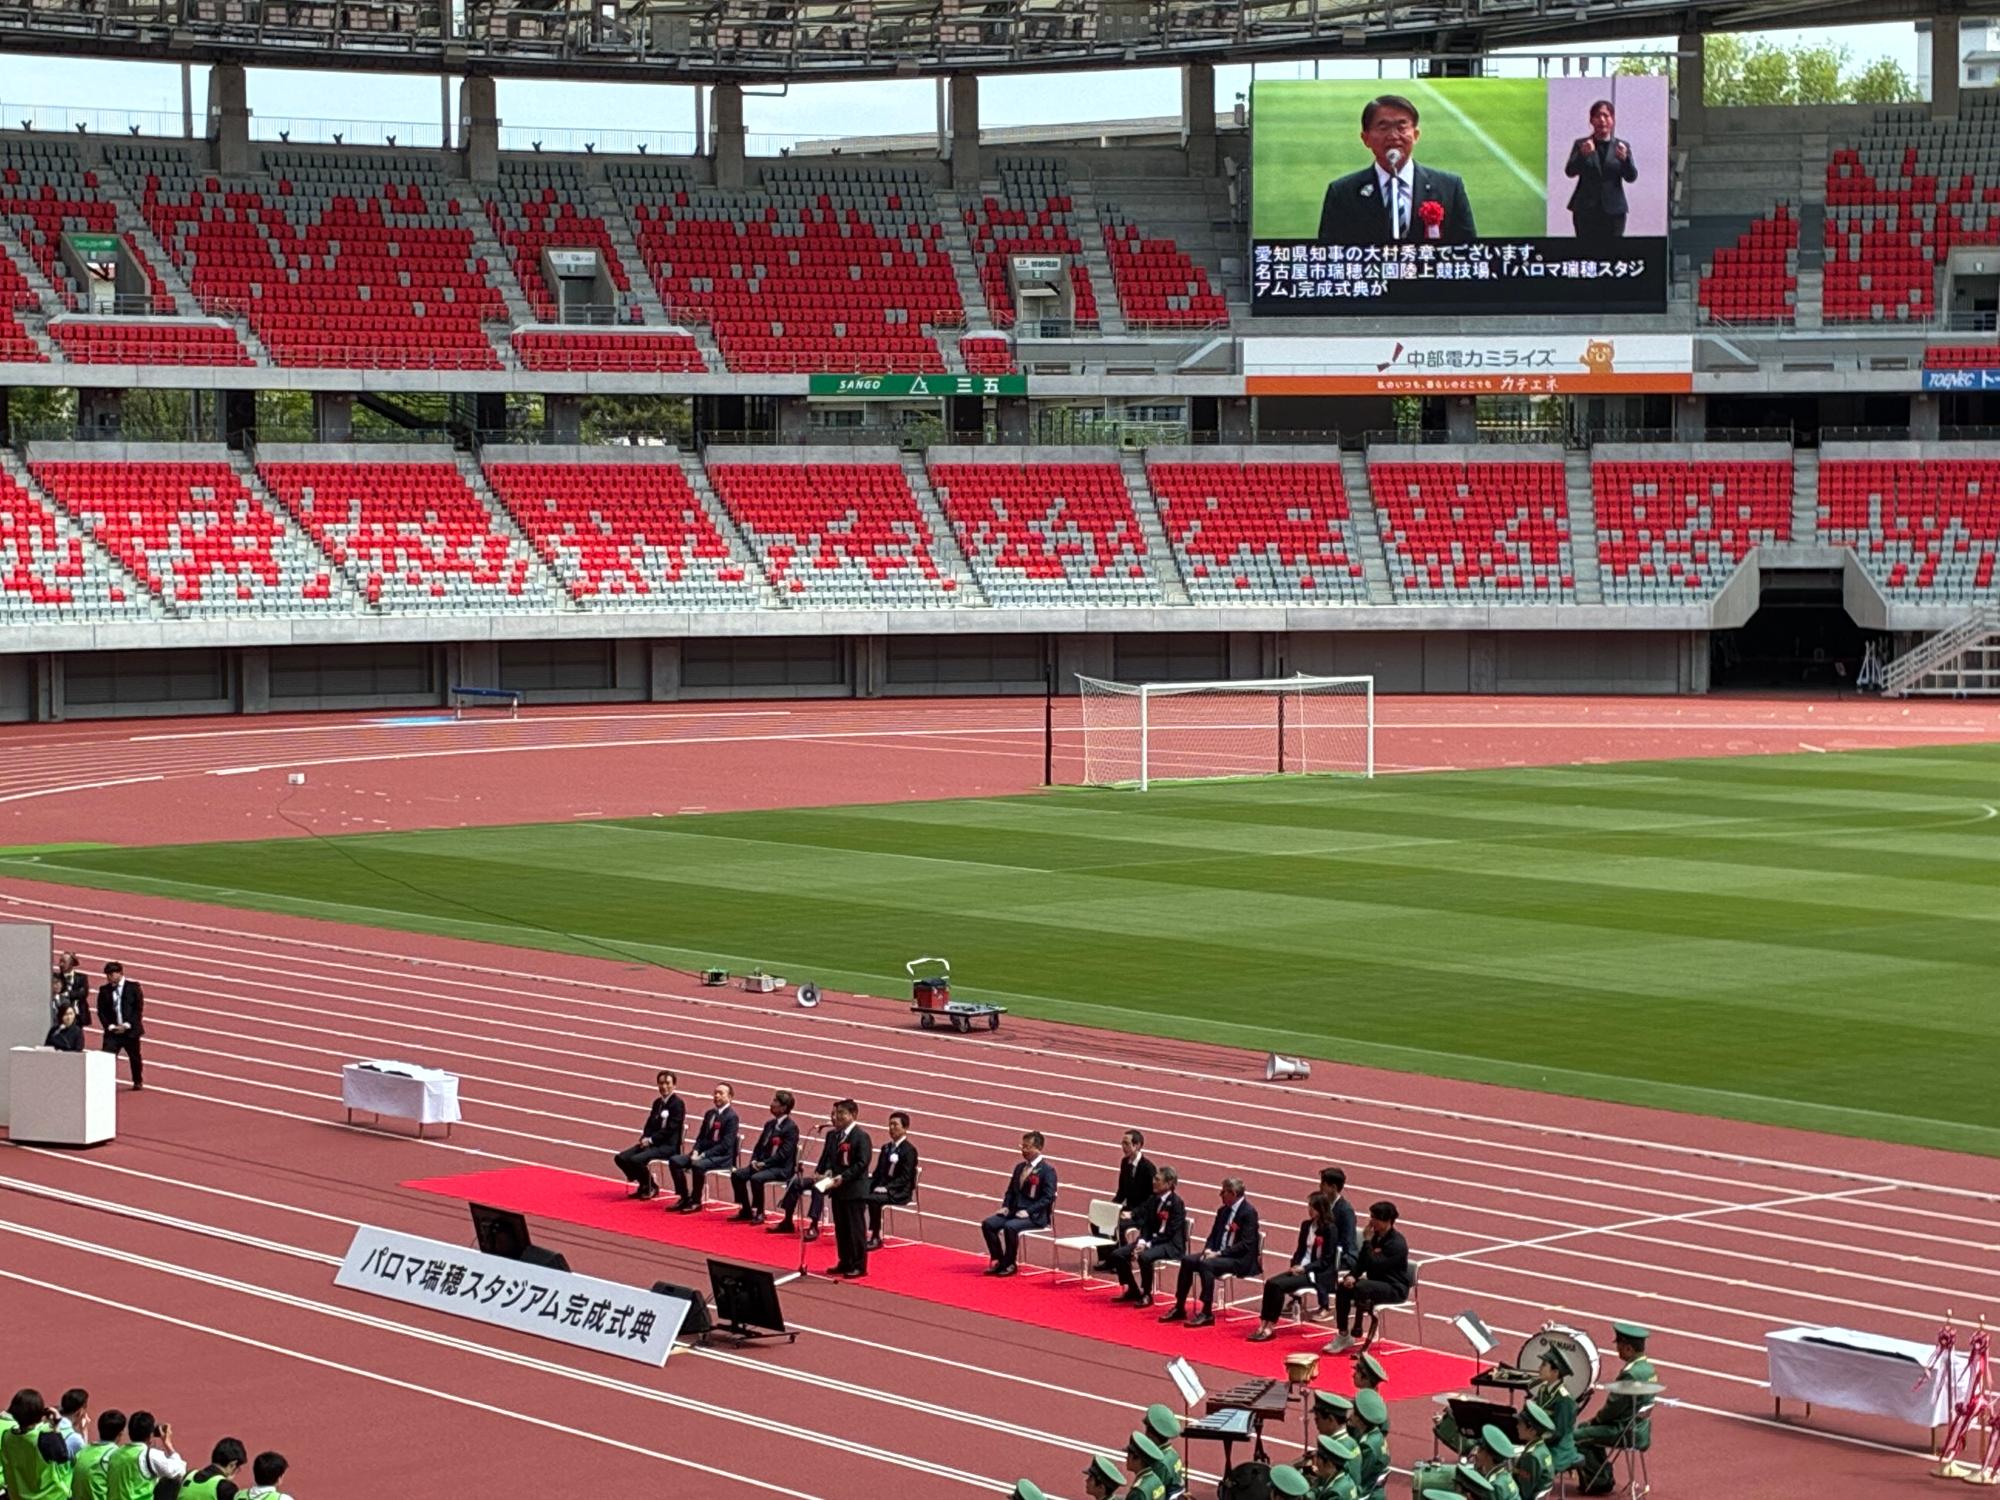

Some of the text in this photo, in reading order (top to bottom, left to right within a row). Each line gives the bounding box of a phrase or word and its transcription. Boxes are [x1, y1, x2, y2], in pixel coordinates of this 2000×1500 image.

[1254, 244, 1543, 263] 愛知県知事の大村秀章でございます。
[1255, 280, 1390, 298] アム」完成式典が
[1407, 349, 1554, 369] 中部電力ミライズ
[839, 380, 881, 390] SANGO
[360, 1246, 657, 1344] パロマ瑞穂スタジアム完成式典
